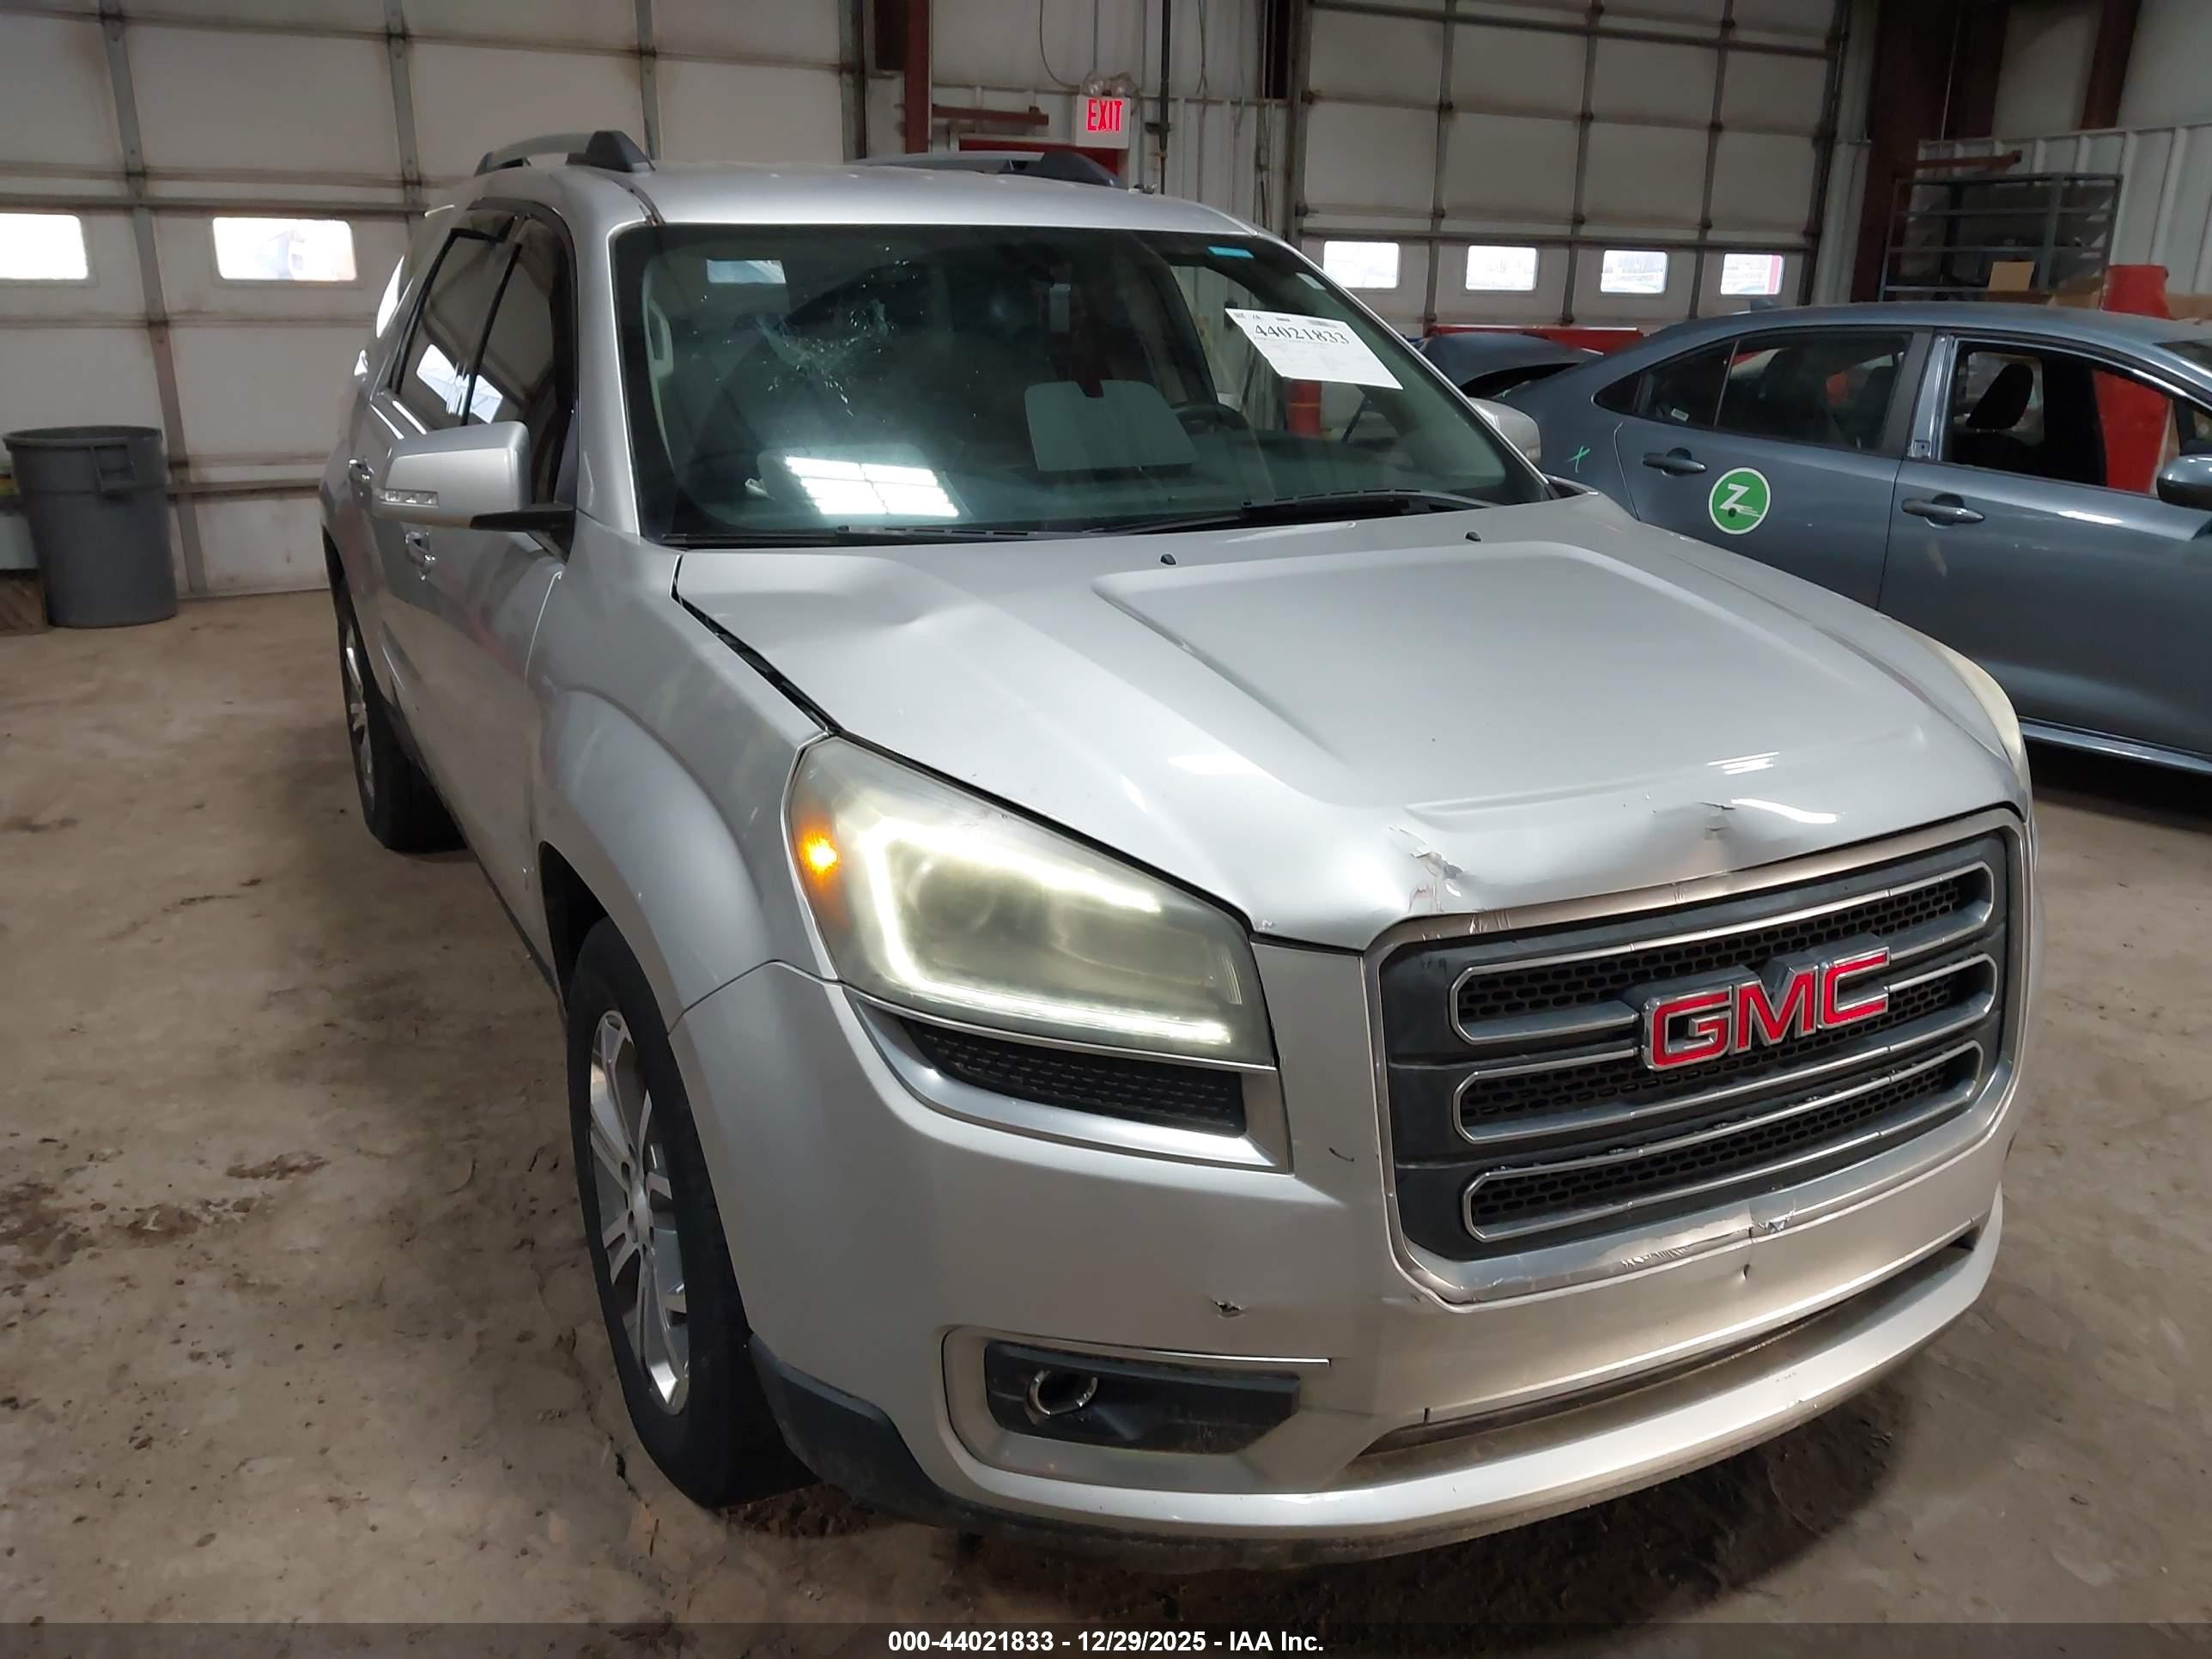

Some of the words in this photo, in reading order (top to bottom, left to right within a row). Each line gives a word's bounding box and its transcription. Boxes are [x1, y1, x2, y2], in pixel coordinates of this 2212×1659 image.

[1086, 99, 1122, 131] EXIT
[1255, 325, 1349, 344] 44021833
[1641, 946, 1890, 1072] GMC
